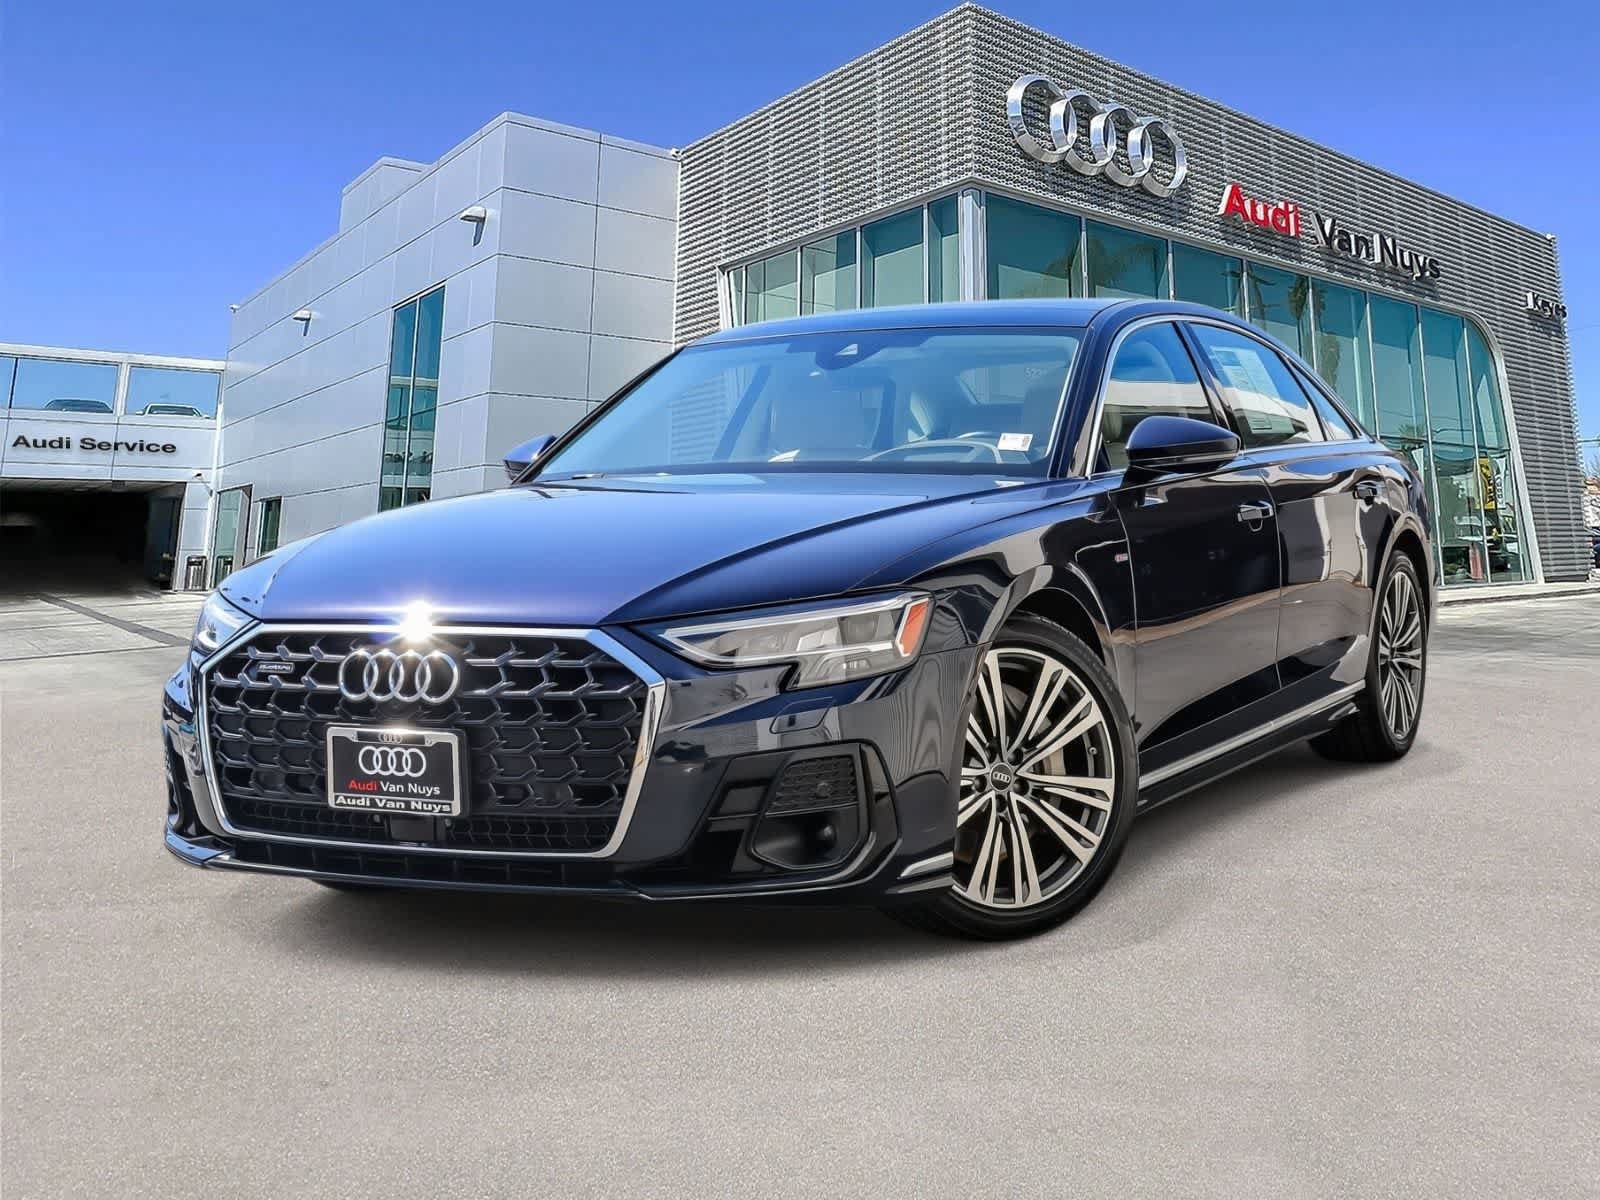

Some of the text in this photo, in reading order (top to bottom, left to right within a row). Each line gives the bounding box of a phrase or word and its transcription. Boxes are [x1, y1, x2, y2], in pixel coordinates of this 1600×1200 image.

[1217, 183, 1441, 281] Audi Van Nuys
[12, 435, 177, 454] Audi Service
[347, 779, 441, 797] Audi Van Nuys
[335, 796, 451, 813] Audi Van Nuys
